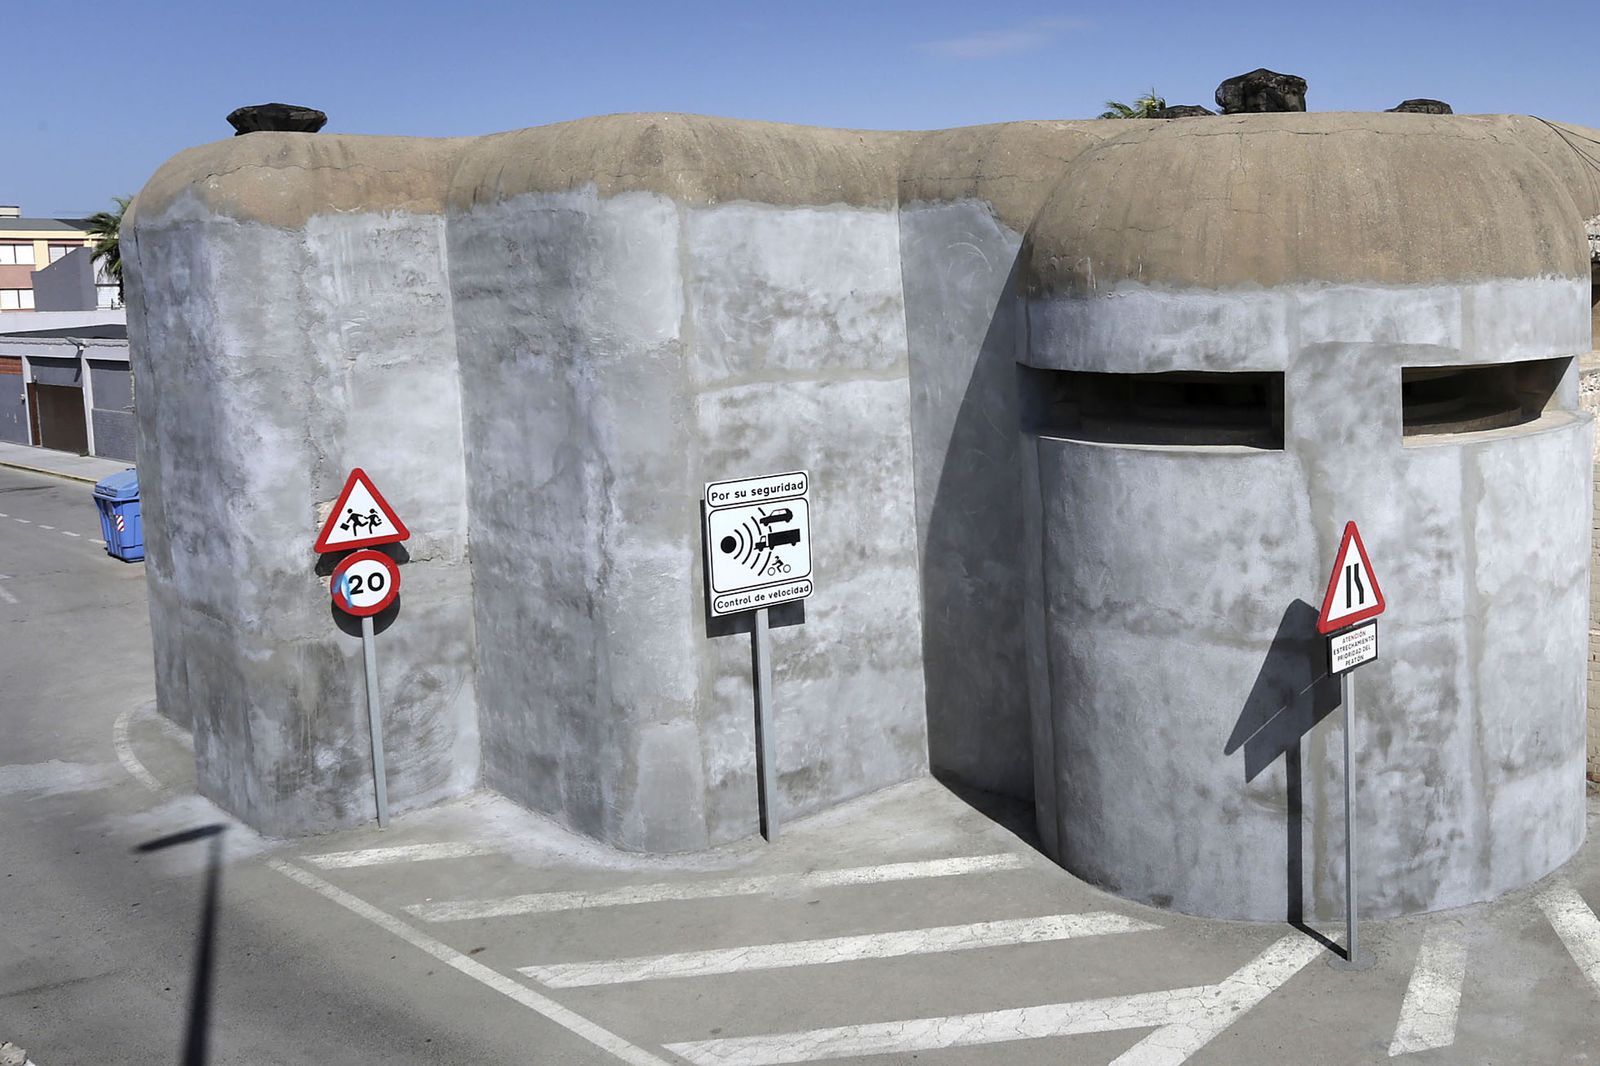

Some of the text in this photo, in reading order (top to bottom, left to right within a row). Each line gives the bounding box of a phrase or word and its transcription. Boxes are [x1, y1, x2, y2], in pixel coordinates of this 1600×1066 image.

[711, 481, 803, 502] Por su seguridad
[348, 572, 384, 595] 20
[717, 585, 809, 609] Control de velocidad
[1333, 635, 1374, 655] ESTRECHAMIENTO
[1337, 647, 1361, 661] PRIORIDAD
